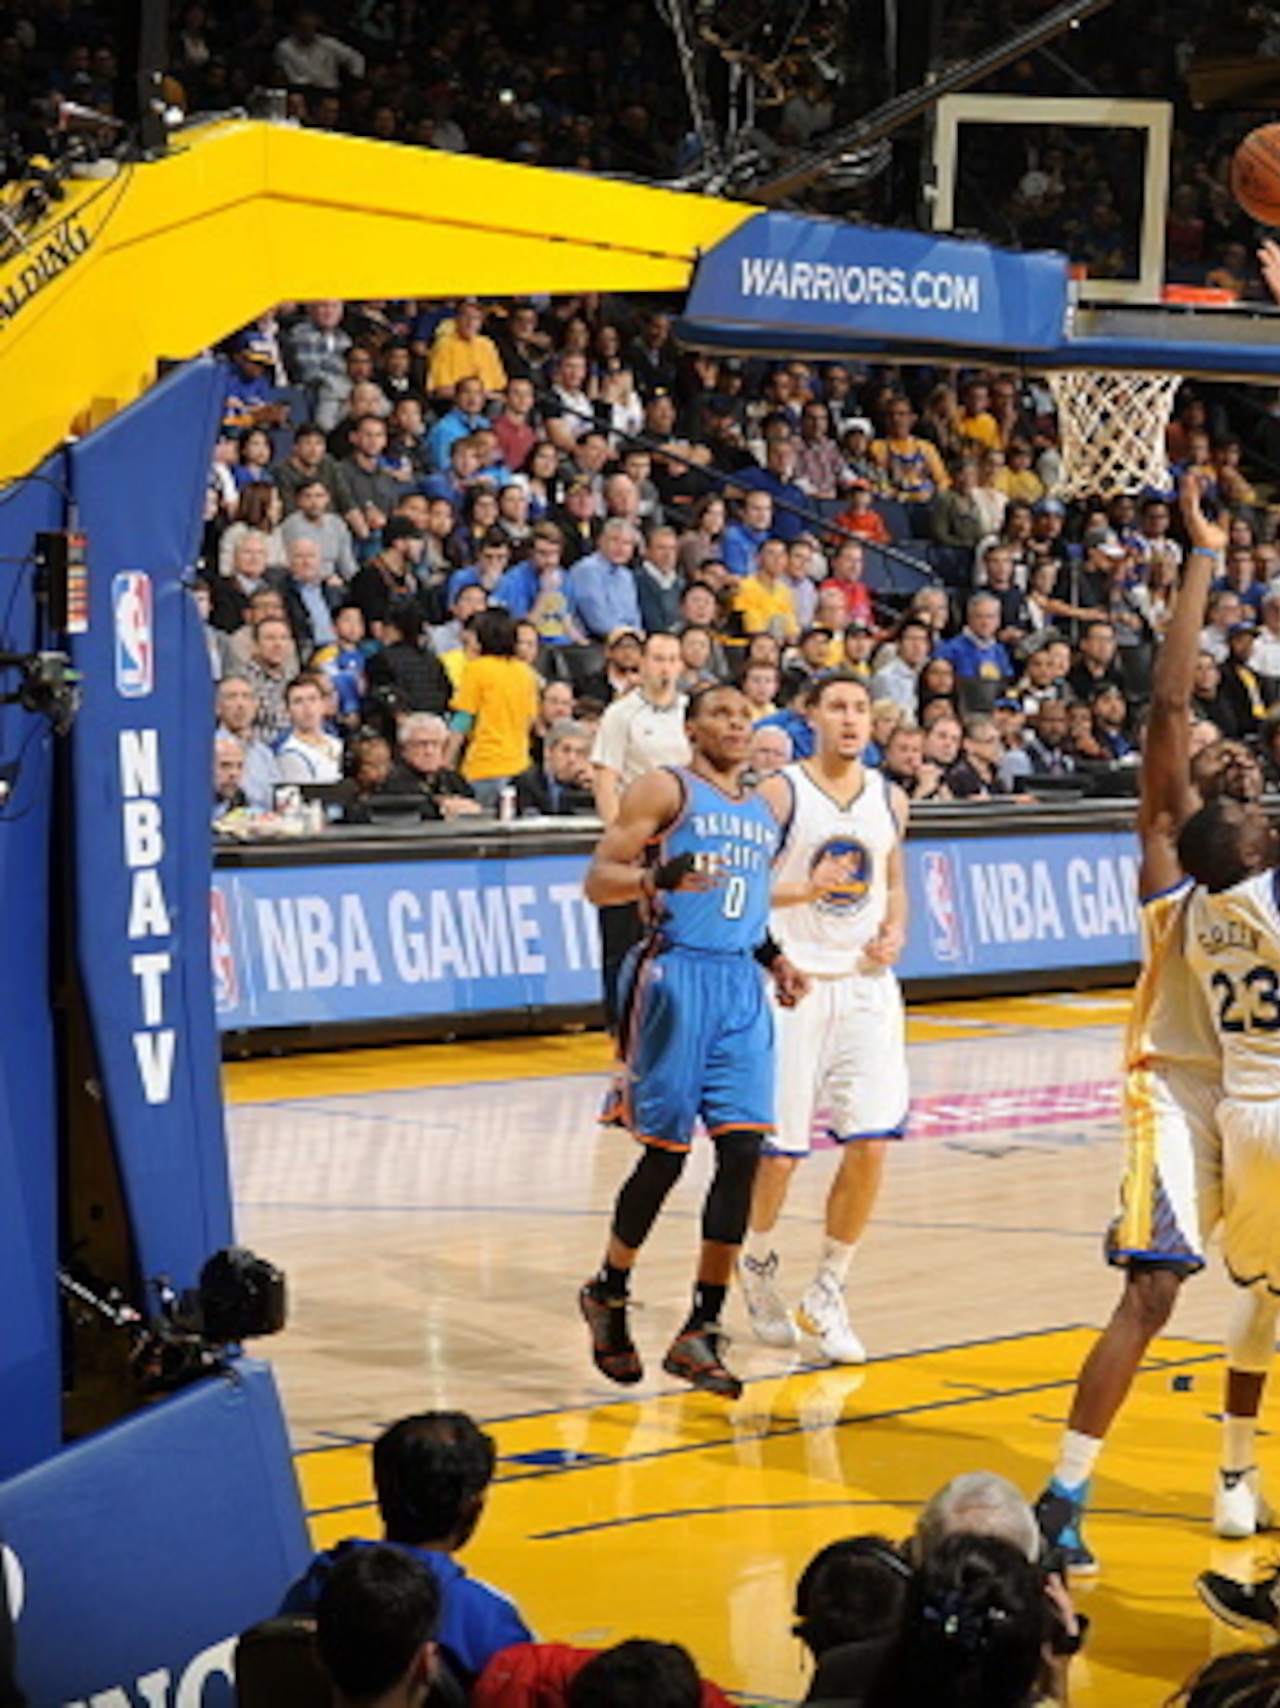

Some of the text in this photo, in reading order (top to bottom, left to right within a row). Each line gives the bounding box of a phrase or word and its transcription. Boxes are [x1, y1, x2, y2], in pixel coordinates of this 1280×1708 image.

[741, 258, 979, 312] WARRIORS.COM
[119, 729, 175, 1104] NBA TV
[256, 895, 382, 991] NBA
[388, 885, 546, 983] GAME
[725, 875, 747, 920] 0
[969, 860, 1065, 943] NBA
